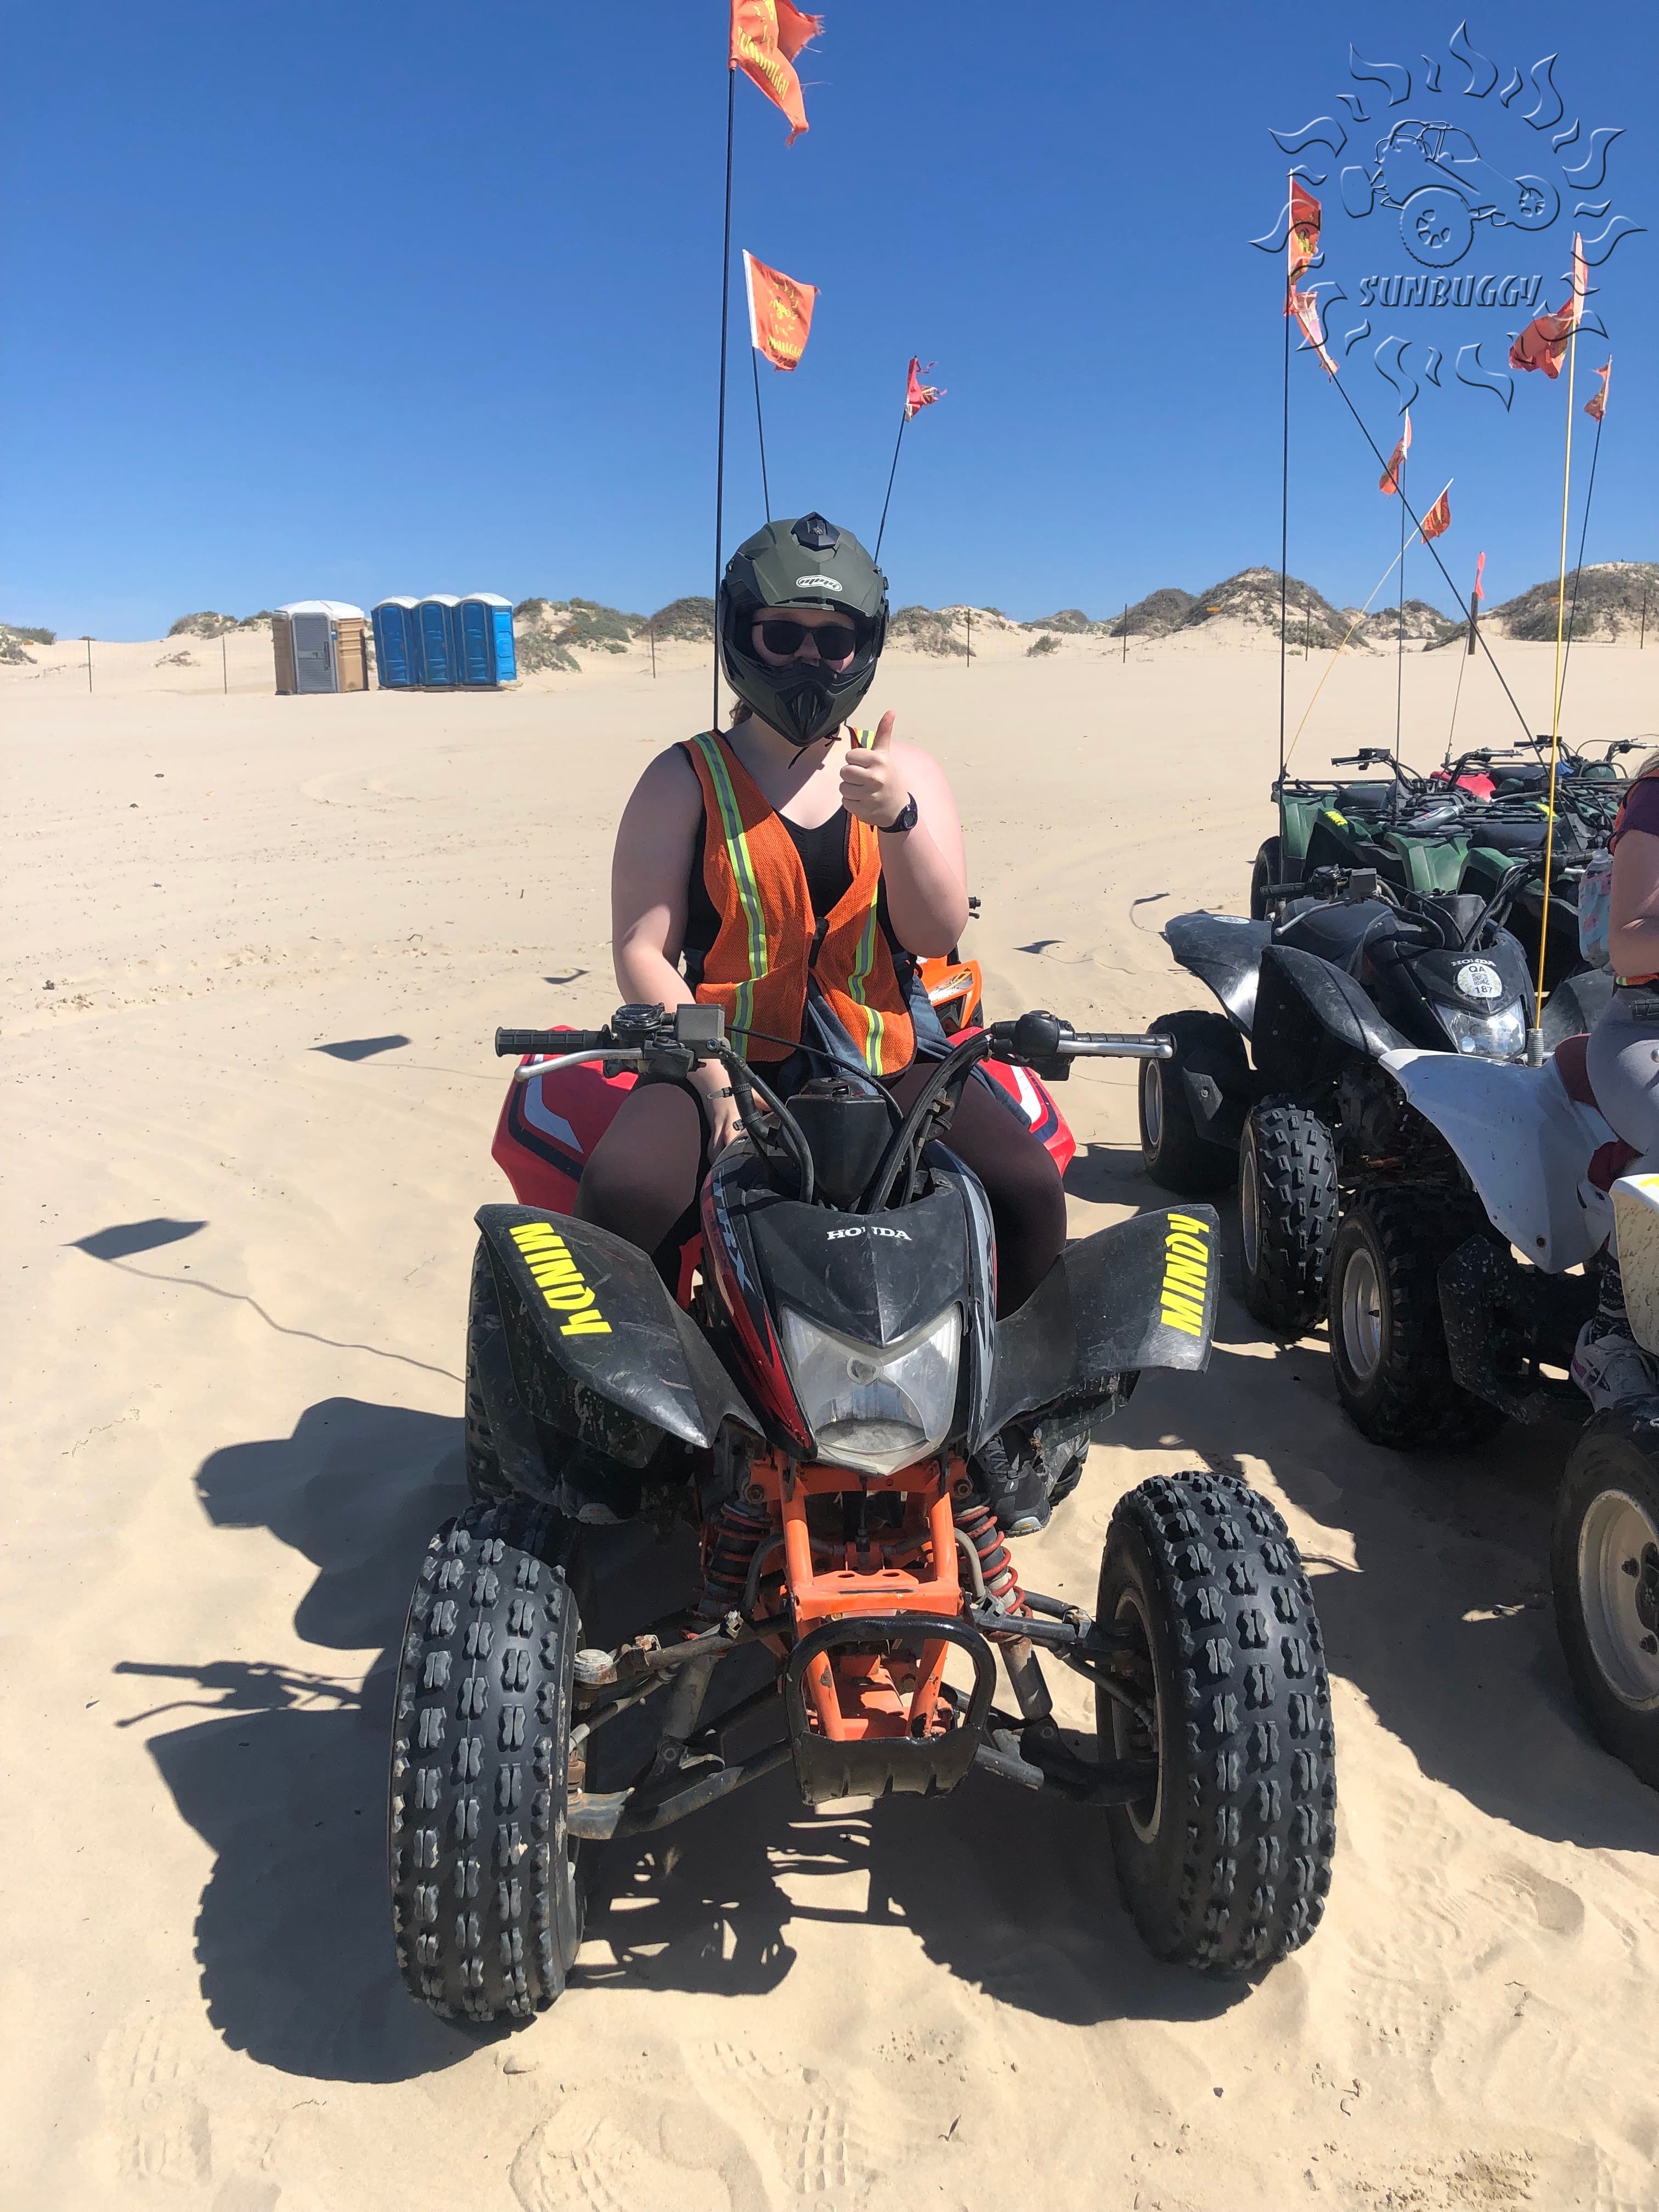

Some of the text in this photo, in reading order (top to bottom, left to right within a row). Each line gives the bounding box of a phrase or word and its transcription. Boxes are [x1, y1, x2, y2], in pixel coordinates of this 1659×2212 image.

[1474, 985, 1493, 994] 187
[509, 1222, 613, 1336] MINDY
[1160, 1213, 1210, 1337] MINDY
